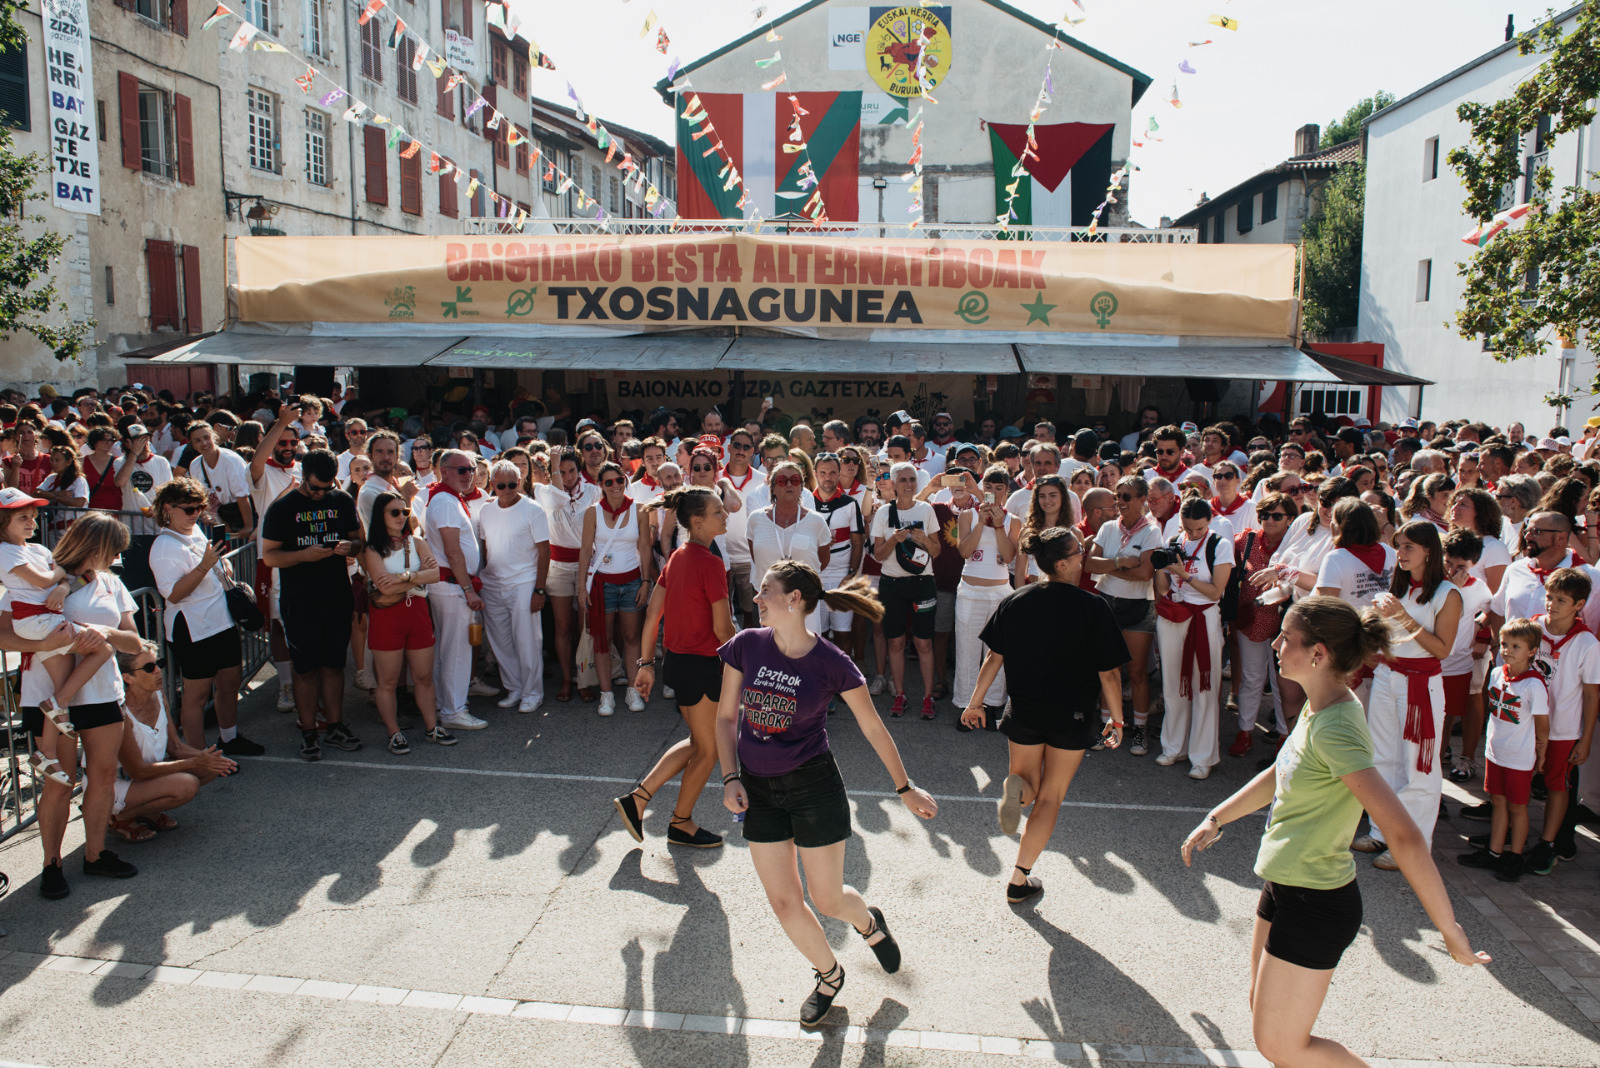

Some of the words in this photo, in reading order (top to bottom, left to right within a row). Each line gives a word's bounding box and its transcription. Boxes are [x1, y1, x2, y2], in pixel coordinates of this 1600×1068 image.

[50, 18, 83, 39] ZIZPA
[877, 8, 909, 29] EUSKAL
[911, 7, 940, 28] HERRIA
[837, 34, 861, 43] NGE
[48, 46, 75, 69] HE
[50, 65, 81, 90] RRI
[889, 82, 929, 95] BURUJA
[52, 91, 85, 115] BAT
[54, 117, 91, 142] GAZ
[54, 135, 78, 157] TE
[55, 156, 91, 179] TXE
[56, 181, 94, 204] BAT
[630, 243, 743, 284] BESTA
[548, 286, 924, 324] TXOSNAGUNEA
[618, 379, 723, 398] BAIONAKO
[789, 379, 905, 398] GAZTETXEA
[295, 509, 339, 523] euskaraz
[310, 521, 328, 533] bizi
[297, 534, 319, 547] nahi
[322, 532, 340, 543] dut
[757, 666, 802, 687] Gazteok
[746, 708, 793, 729] ORROKA
